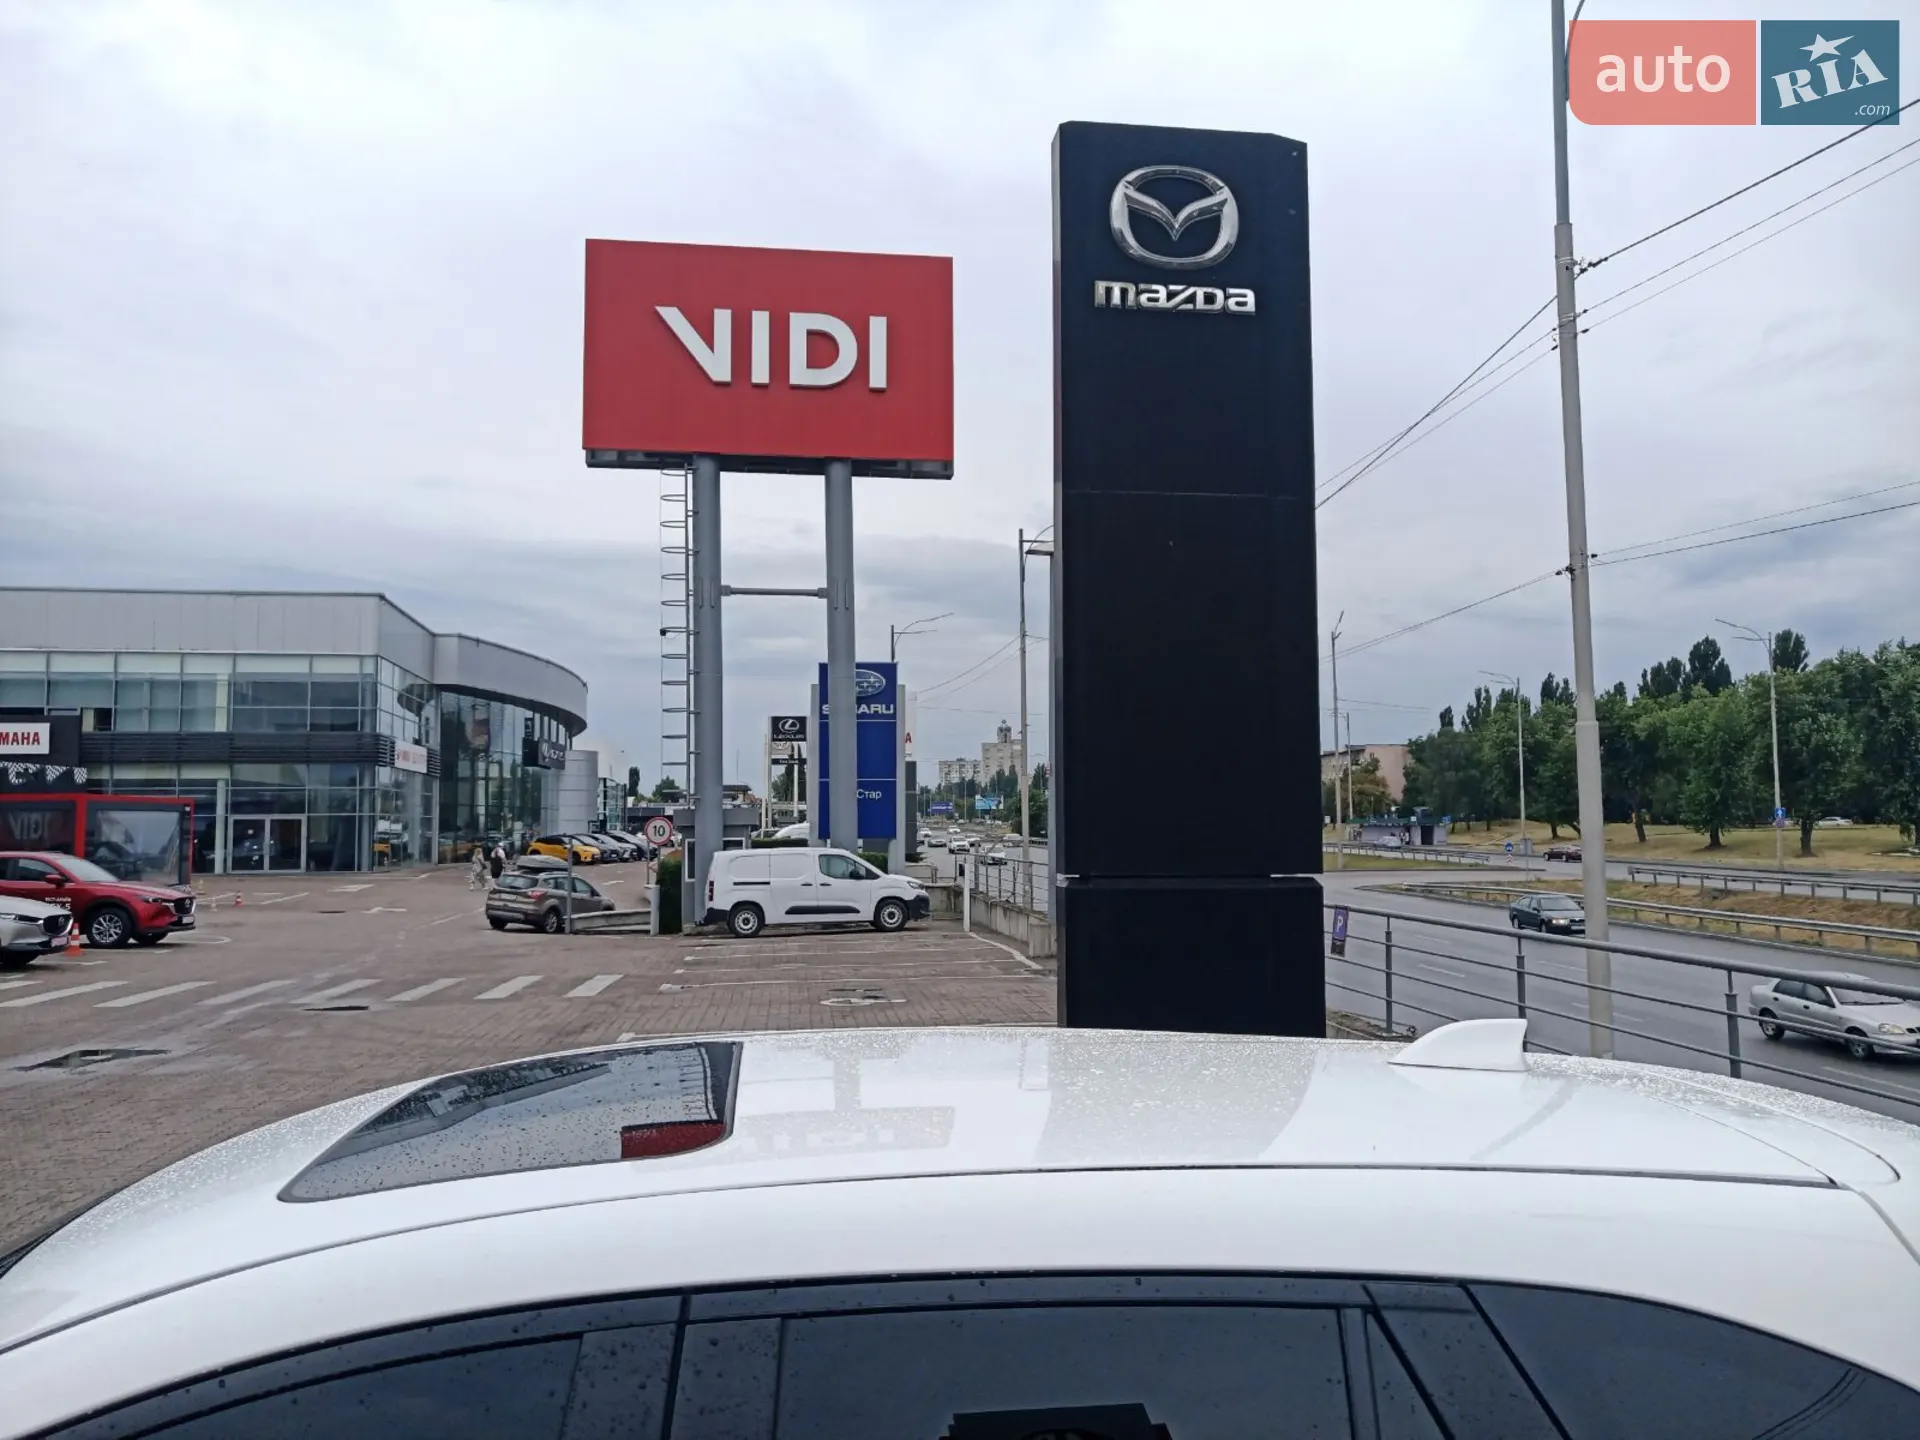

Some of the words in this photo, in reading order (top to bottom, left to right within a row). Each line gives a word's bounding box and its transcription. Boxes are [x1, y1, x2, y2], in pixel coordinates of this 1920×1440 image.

[654, 305, 888, 391] VIDI
[822, 704, 894, 714] SARU
[652, 825, 666, 837] 10
